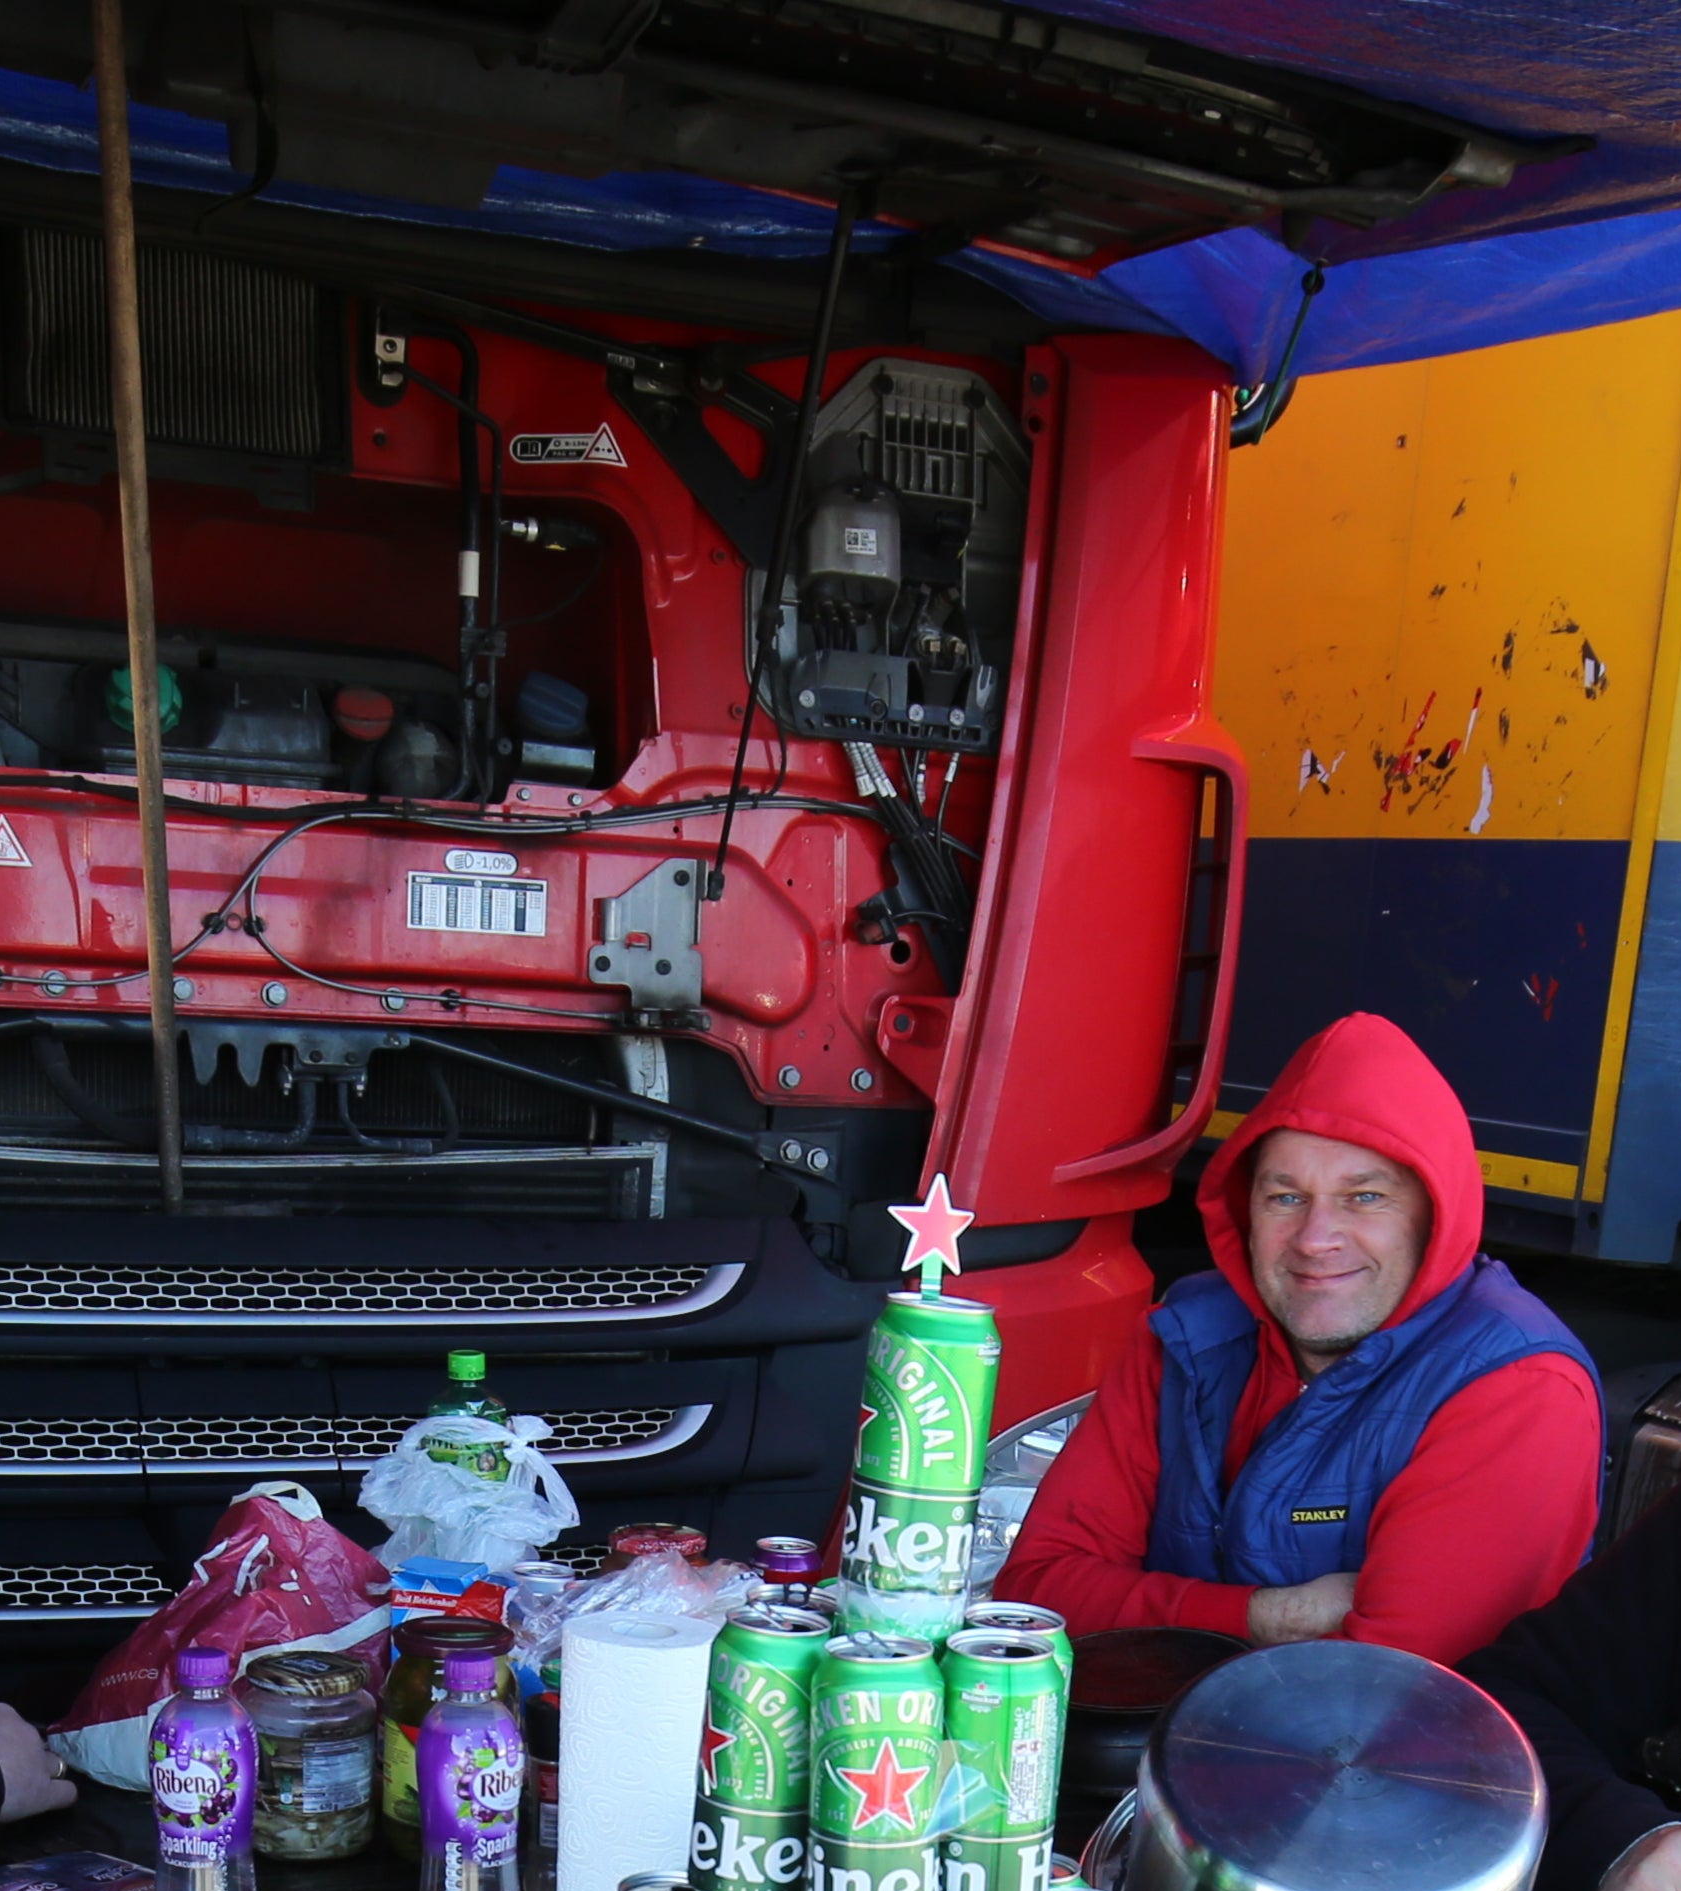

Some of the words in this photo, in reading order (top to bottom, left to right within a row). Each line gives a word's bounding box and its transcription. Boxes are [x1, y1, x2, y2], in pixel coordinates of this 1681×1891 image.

[868, 1327, 956, 1469] ORIGINAL
[1292, 1509, 1346, 1522] STANLEY
[715, 1653, 810, 1787] ORIGINAL
[154, 1766, 218, 1797] Ribena
[160, 1830, 219, 1861] Sparkling
